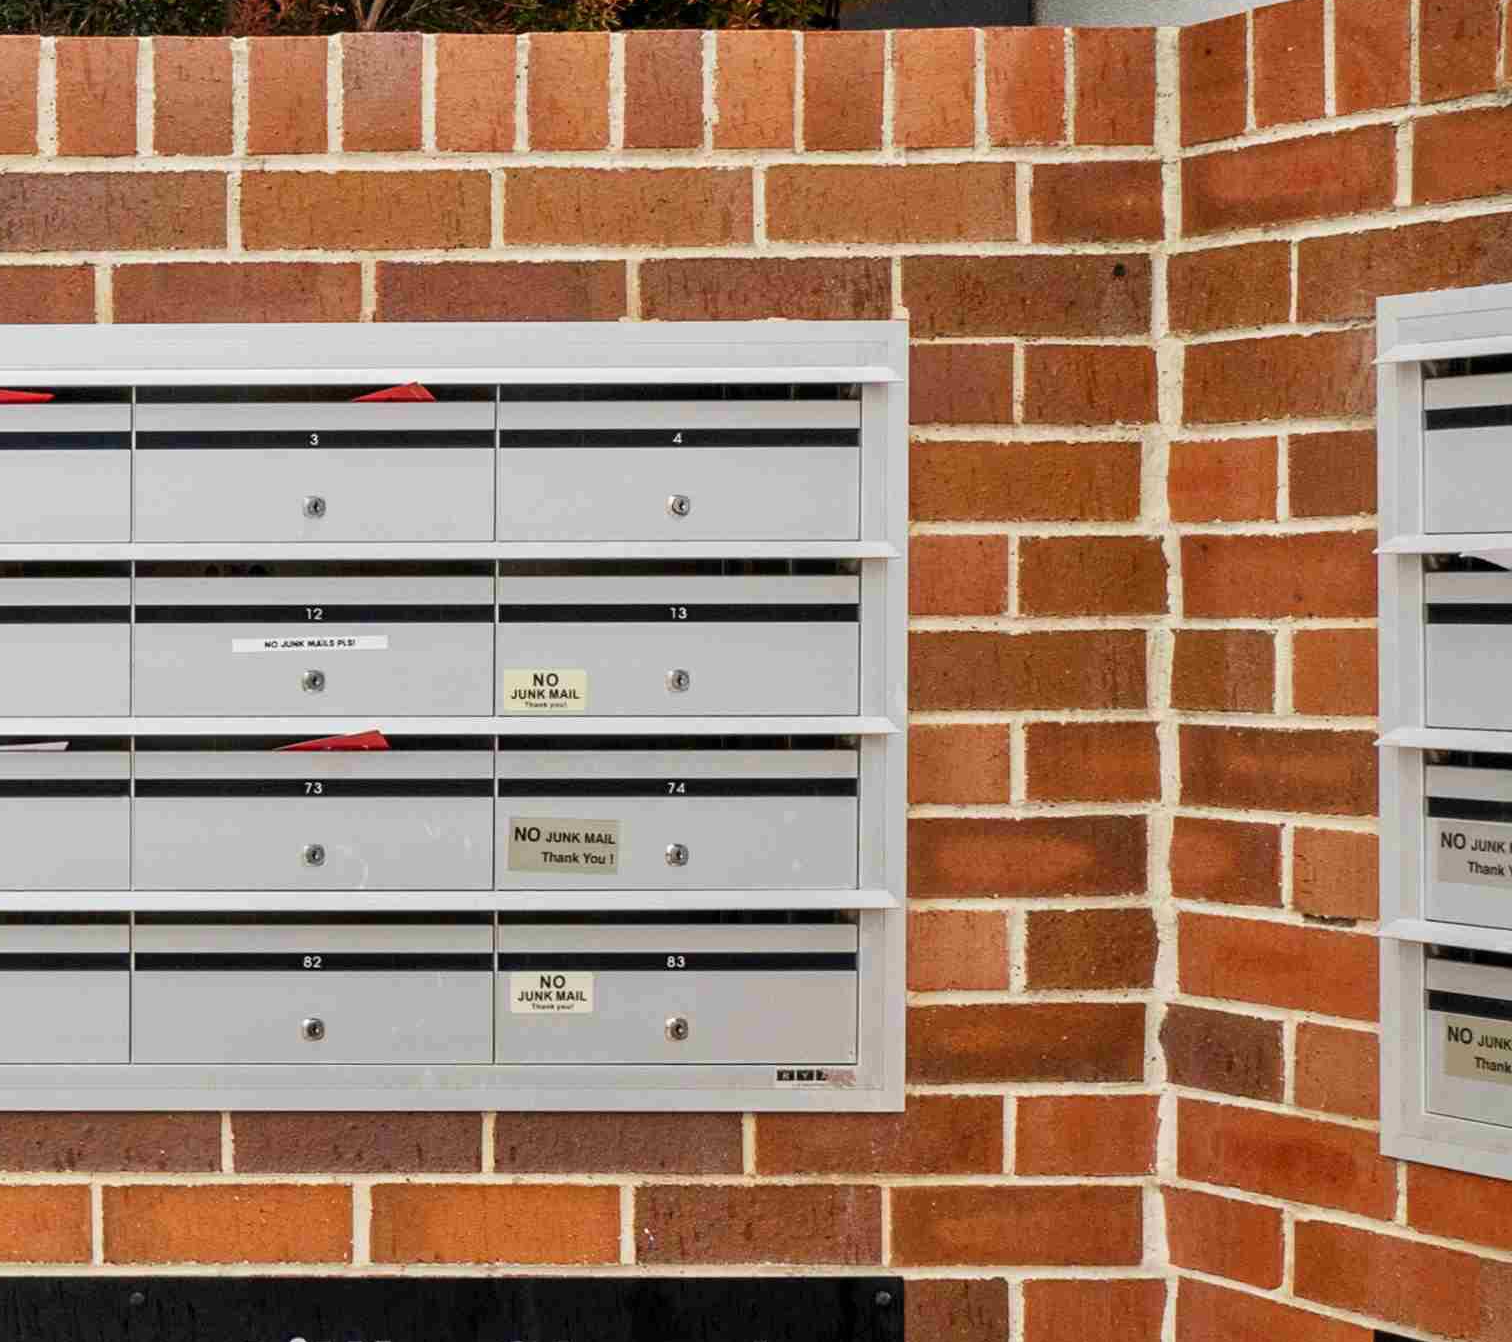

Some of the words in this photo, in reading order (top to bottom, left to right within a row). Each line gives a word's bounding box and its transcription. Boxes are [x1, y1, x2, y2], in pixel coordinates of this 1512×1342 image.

[309, 433, 319, 446] 3
[672, 432, 683, 444] 4
[306, 607, 323, 621] 12
[670, 606, 688, 620] 13
[264, 640, 278, 648] NO
[533, 673, 559, 687] NO
[511, 689, 545, 700] JUNK
[549, 688, 579, 700] MAIL
[304, 781, 323, 795] 73
[667, 782, 686, 794] 74
[514, 826, 541, 842] NO
[545, 832, 580, 844] JUNK
[584, 832, 615, 845] MAIL
[1441, 832, 1466, 850] NO
[1471, 840, 1505, 853] JUNK
[541, 851, 579, 863] Thank
[583, 852, 606, 865] You
[1467, 860, 1505, 876] Thank
[303, 955, 322, 969] 82
[666, 955, 686, 968] 83
[540, 974, 566, 989] NO
[518, 991, 553, 1002] JUNK
[556, 990, 585, 1001] MAIL
[531, 1002, 555, 1010] Thank
[1447, 1025, 1473, 1045] NO
[1477, 1034, 1512, 1051] JUNK
[1474, 1056, 1512, 1074] Thank
